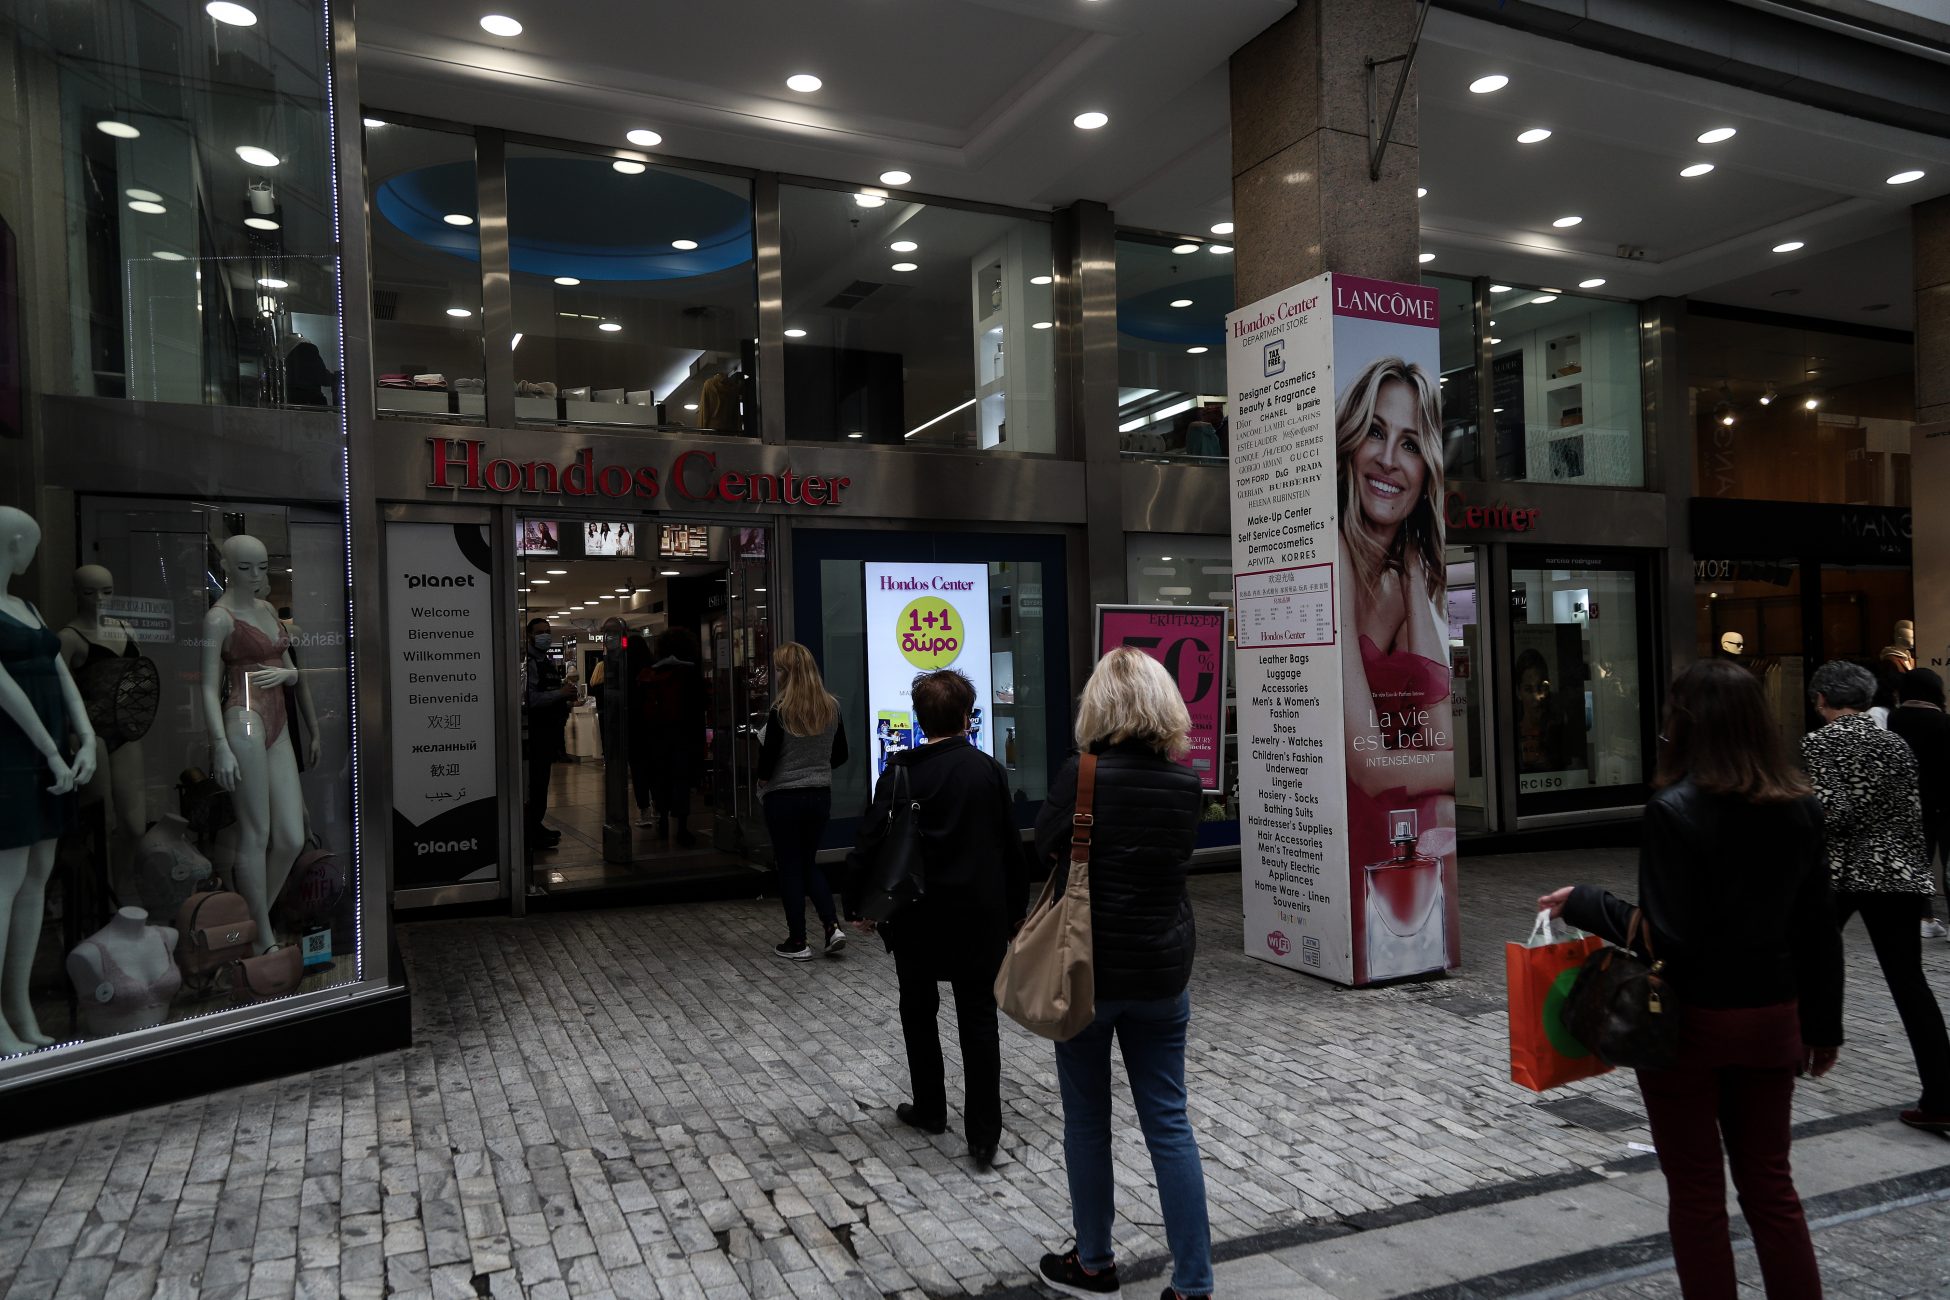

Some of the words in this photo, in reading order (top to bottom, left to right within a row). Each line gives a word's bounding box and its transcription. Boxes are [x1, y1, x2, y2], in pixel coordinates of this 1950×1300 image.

[1337, 287, 1435, 320] LANCÔME
[1234, 312, 1276, 338] Hondos
[1277, 295, 1319, 319] Center
[1242, 323, 1285, 348] DEPARTMENT
[1286, 315, 1309, 334] STORE
[1268, 348, 1280, 360] TAX
[1268, 355, 1281, 368] FREE
[1239, 385, 1272, 402] Designer
[1273, 370, 1316, 390] Cosmetics
[1239, 402, 1265, 415] Beauty
[1266, 398, 1272, 407] &
[1274, 385, 1316, 403] Fragrance
[1236, 419, 1252, 430] Dior
[1260, 408, 1288, 422] CHANEL
[1287, 411, 1321, 426] CLARINS
[1234, 451, 1259, 465] CLINIQUE
[1262, 444, 1293, 458] SHISEIDO
[1238, 463, 1261, 475] GIORGIO
[1289, 448, 1320, 462] GUCCI
[426, 437, 661, 498] Hondos
[671, 449, 851, 506] Center
[1236, 478, 1251, 487] TOM
[1251, 473, 1270, 484] FORD
[1275, 468, 1289, 479] D&G
[1295, 461, 1323, 474] PRADA
[1237, 487, 1264, 499] GUERLAIN
[1269, 474, 1322, 491] BURBERRY
[1248, 496, 1272, 509] HELENA
[1272, 489, 1311, 503] RUBINSTEIN
[1247, 512, 1282, 526] Make-Up
[1284, 507, 1312, 519] Center
[1443, 490, 1541, 531] Center
[1238, 532, 1251, 543] Self
[1252, 528, 1281, 540] Service
[1282, 520, 1325, 535] Cosmetics
[1841, 513, 1912, 538] MANG
[1248, 537, 1314, 554] Dermocosmetics
[1247, 557, 1275, 567] APIVITA
[1281, 550, 1316, 562] KORRES
[404, 573, 475, 588] planet
[880, 575, 929, 590] Hondos
[931, 575, 974, 591] Center
[411, 606, 470, 618] Welcome
[909, 608, 952, 631] 1+1
[408, 628, 475, 640] Bienvenue
[1261, 631, 1284, 641] Hondos
[1284, 629, 1306, 640] Center
[902, 633, 958, 656] δώρο
[403, 650, 481, 662] Willkommen
[1259, 654, 1288, 664] Leather
[1289, 653, 1310, 665] Bags
[408, 671, 477, 683] Benvenuto
[1267, 669, 1302, 680] Luggage
[1261, 683, 1309, 693] Accessories
[408, 692, 479, 705] Bienvenida
[1252, 697, 1273, 706] Men's
[1276, 697, 1281, 706] &
[1284, 697, 1320, 707] Women's
[1270, 708, 1300, 718] Fashion
[1368, 708, 1392, 728] La
[1397, 706, 1430, 727] vie
[427, 714, 462, 730] 欢迎
[1273, 723, 1297, 734] Shoes
[412, 740, 477, 753] желанный
[1251, 735, 1280, 747] Jewelry
[1288, 736, 1323, 747] Watches
[1353, 730, 1392, 751] est
[1397, 727, 1446, 750] belle
[1252, 750, 1290, 762] Children's
[1292, 752, 1323, 764] Fashion
[1266, 763, 1309, 775] Underwear
[1272, 777, 1303, 789] Lingerie
[1258, 789, 1287, 802] Hosiery
[1294, 793, 1319, 804] Socks
[1264, 803, 1293, 818] Bathing
[1295, 807, 1314, 818] Suits
[1248, 816, 1296, 831] Hairdresser's
[1298, 822, 1333, 836] Supplies
[413, 837, 479, 856] planet
[1257, 830, 1273, 841] Hair
[1274, 832, 1323, 849] Accessories
[1258, 842, 1281, 854] Men's
[1282, 846, 1323, 862] Treatment
[1261, 856, 1288, 871] Beauty
[1290, 861, 1321, 875] Electric
[1268, 869, 1314, 887] Appliances
[1255, 880, 1277, 893] Home
[1279, 886, 1300, 898] Ware
[1308, 891, 1330, 904] Linen
[1273, 896, 1311, 913] Souvenirs
